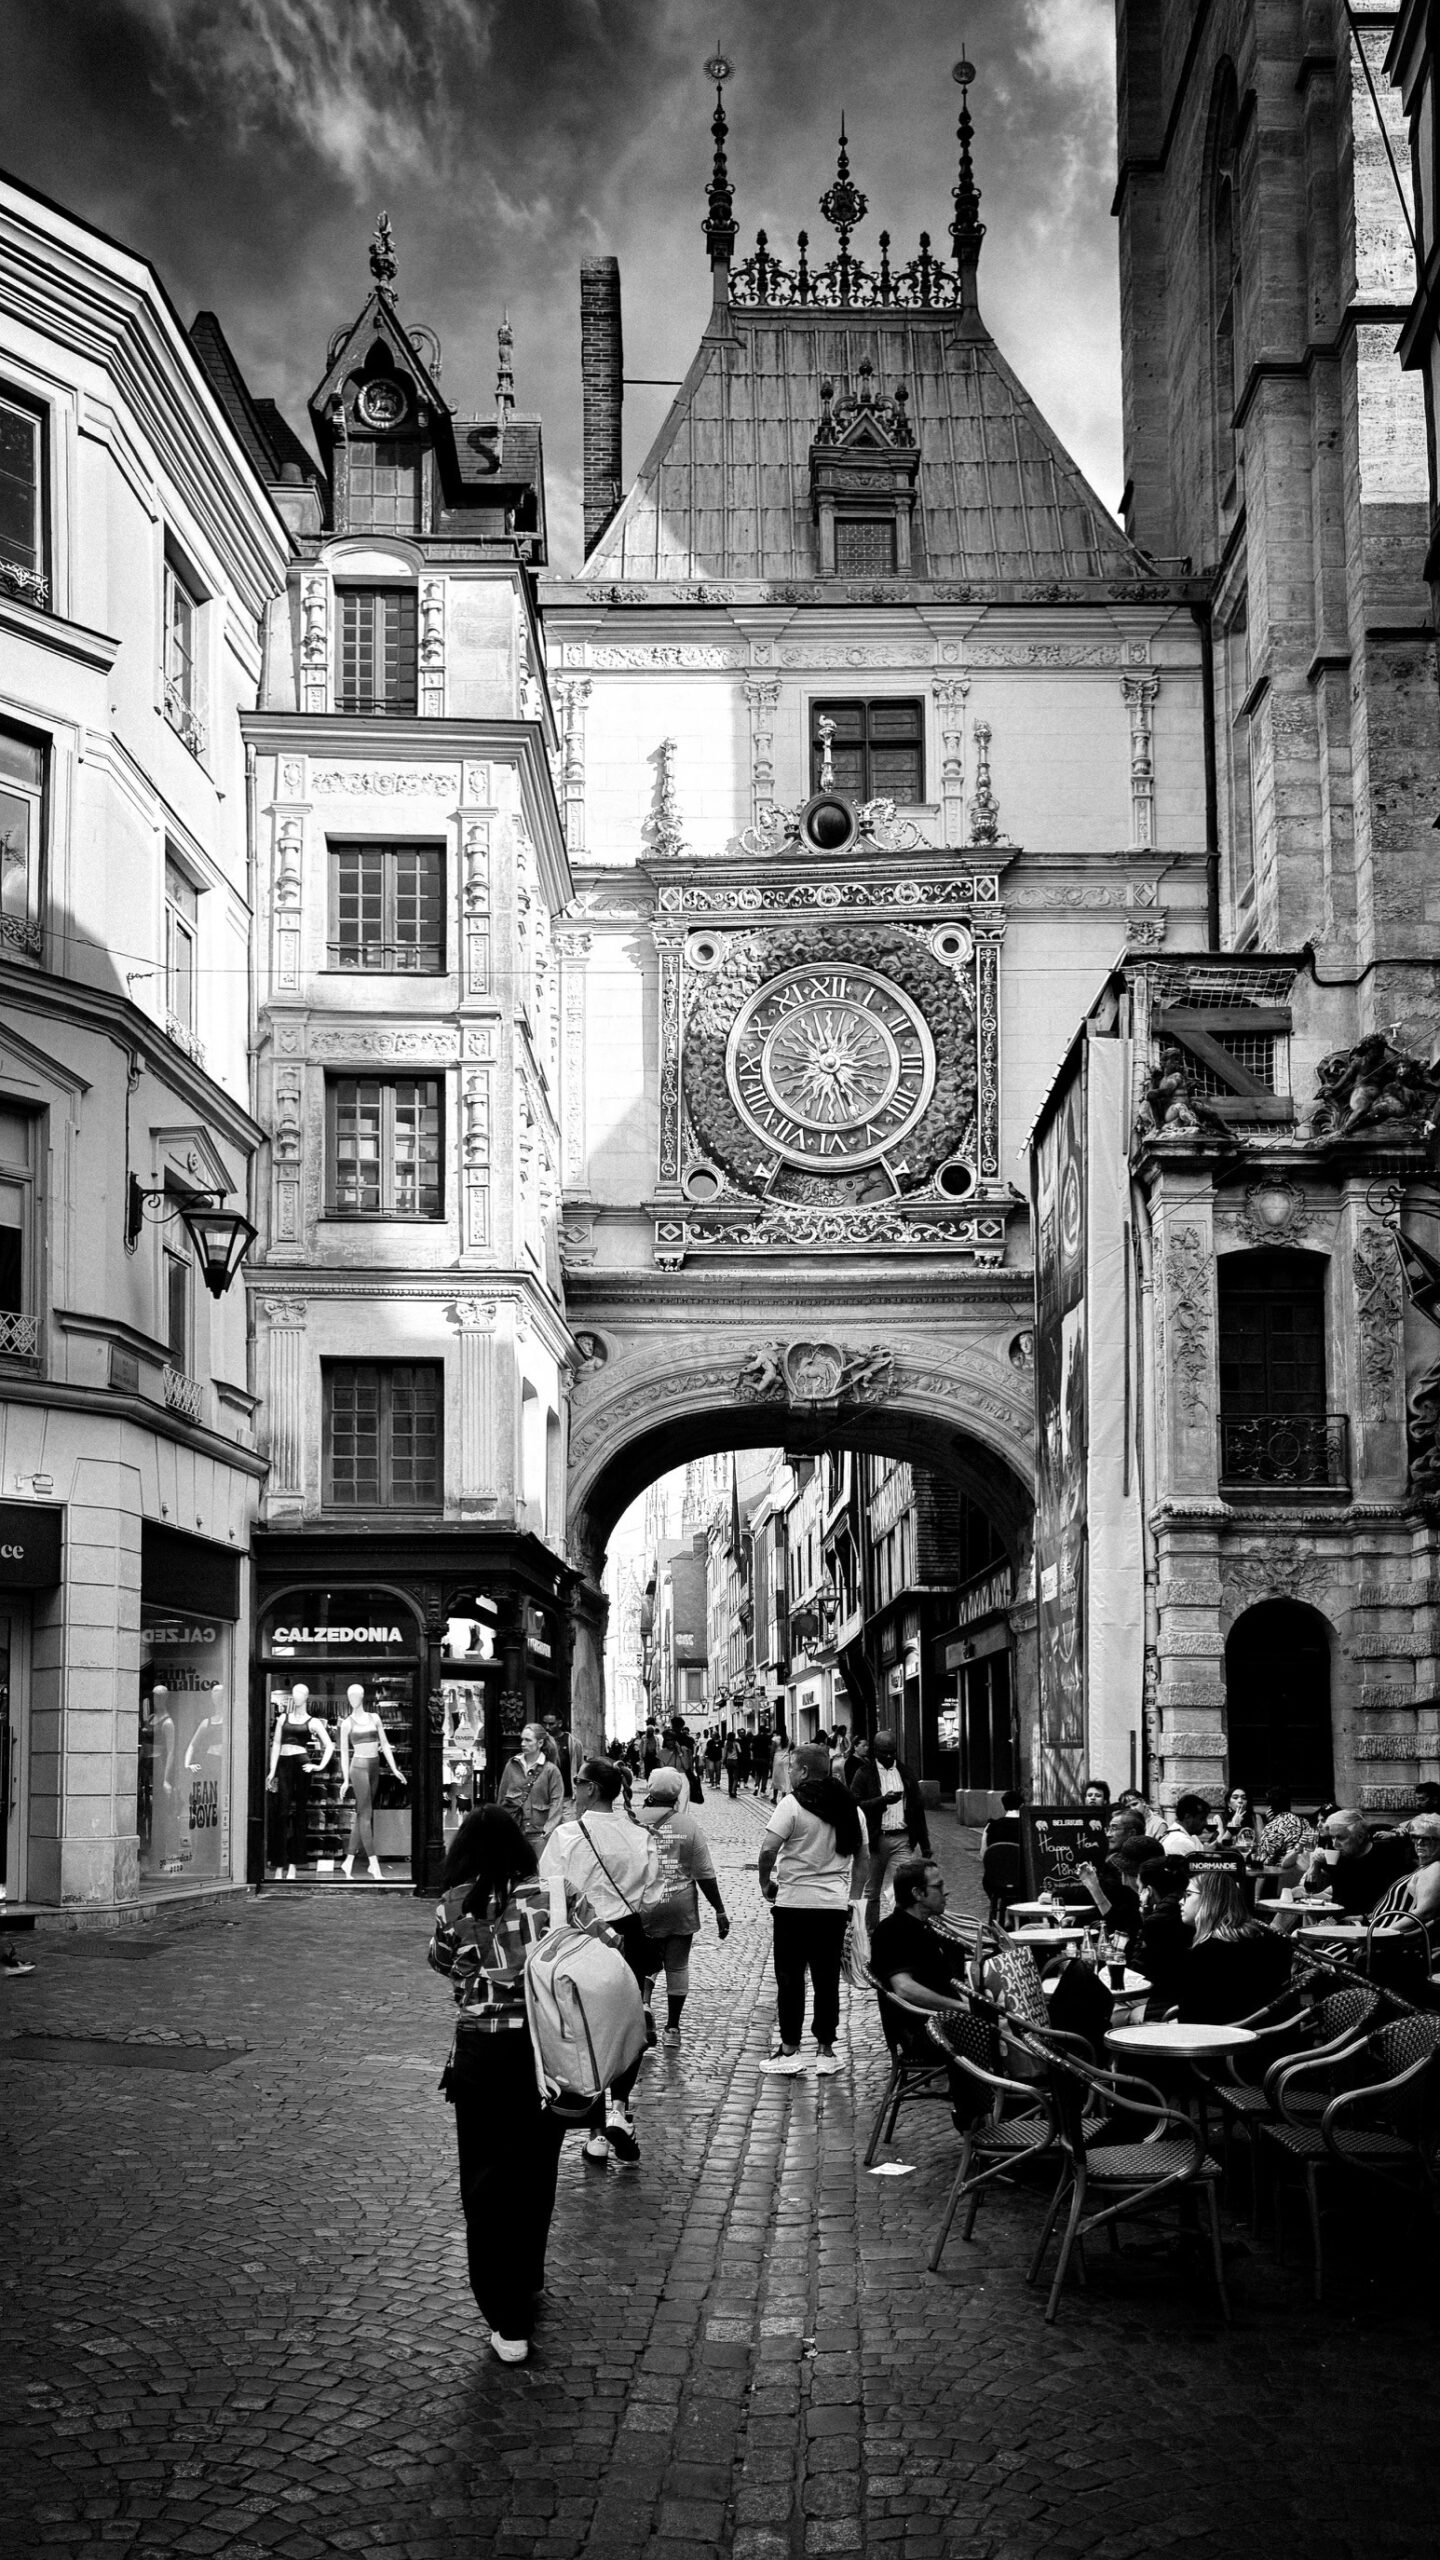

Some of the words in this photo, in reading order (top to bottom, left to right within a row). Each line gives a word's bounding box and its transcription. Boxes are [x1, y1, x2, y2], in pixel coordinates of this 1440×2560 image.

[809, 977, 847, 998] XII
[772, 987, 805, 1014] XI
[746, 1016, 774, 1042] X
[887, 1015, 911, 1035] II
[739, 1052, 761, 1081] IX
[902, 1052, 922, 1074] III
[744, 1083, 775, 1129] VIII
[773, 1118, 806, 1151] VII
[819, 1133, 848, 1154] VI
[865, 1123, 886, 1145] V
[0, 1544, 24, 1559] ce
[273, 1626, 403, 1643] CALZEDONIA
[189, 1781, 218, 1804] JEAN
[189, 1804, 218, 1830] LOVE
[1039, 1833, 1074, 1861] Happy
